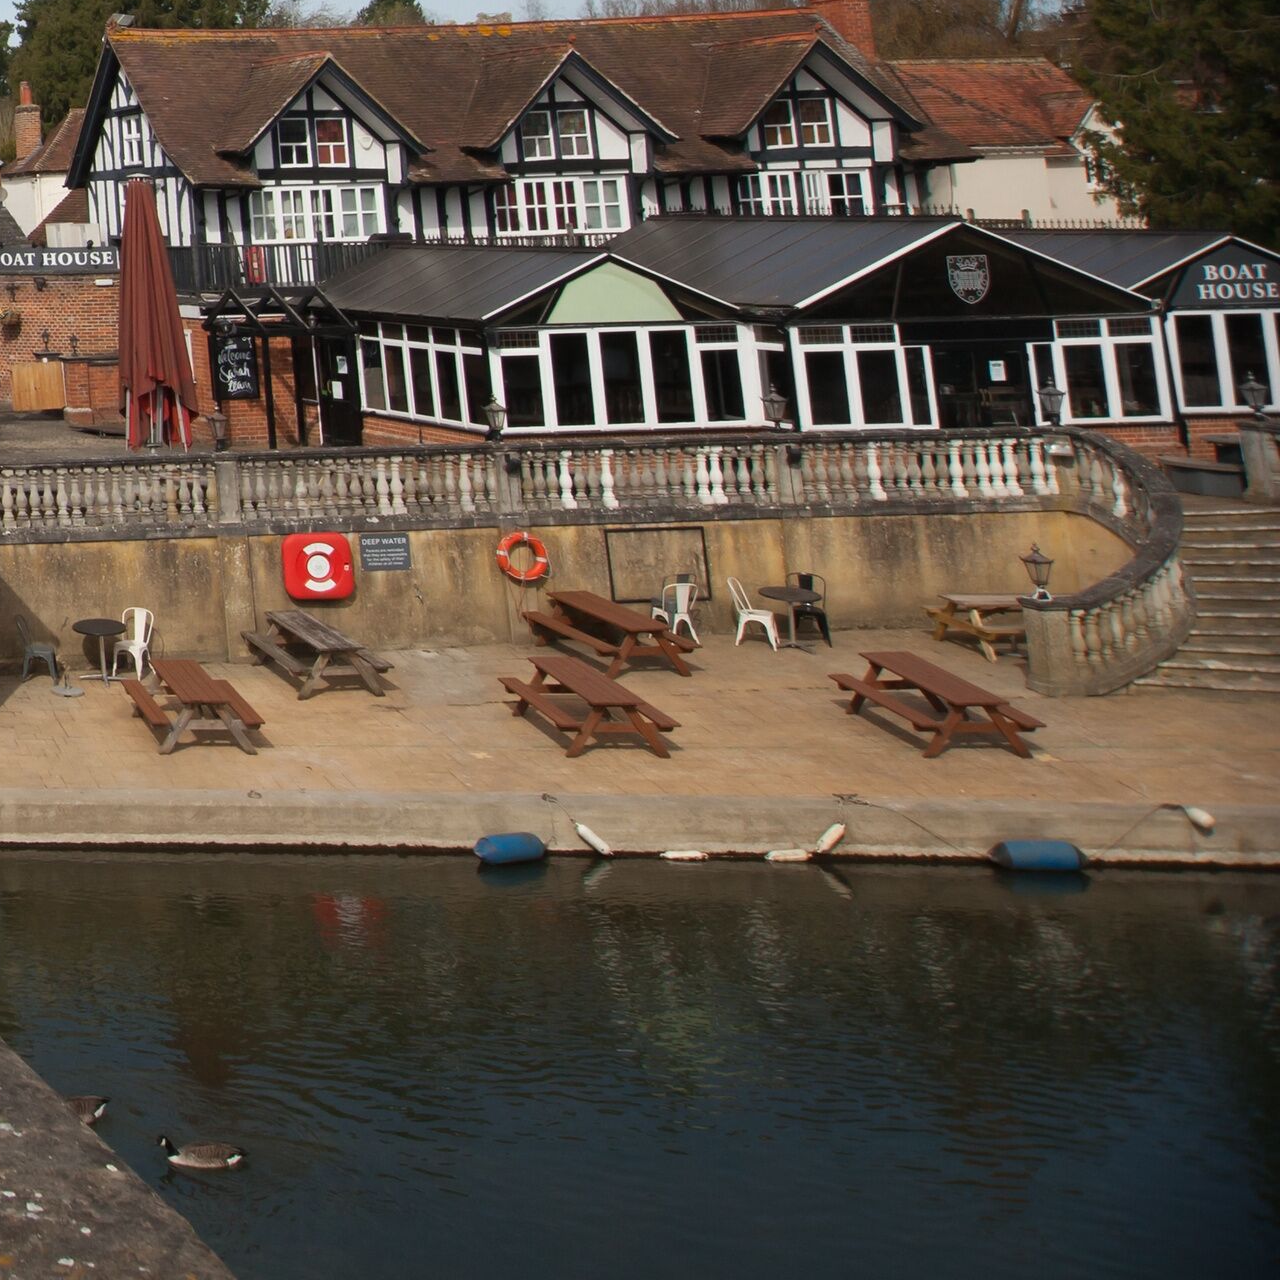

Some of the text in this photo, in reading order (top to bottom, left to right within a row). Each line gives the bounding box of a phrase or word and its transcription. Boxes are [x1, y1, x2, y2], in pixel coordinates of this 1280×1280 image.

[42, 251, 114, 266] HOUSE
[1202, 264, 1267, 280] BOAT
[1197, 282, 1280, 299] HOUSE
[361, 537, 407, 546] DEEP WATER
